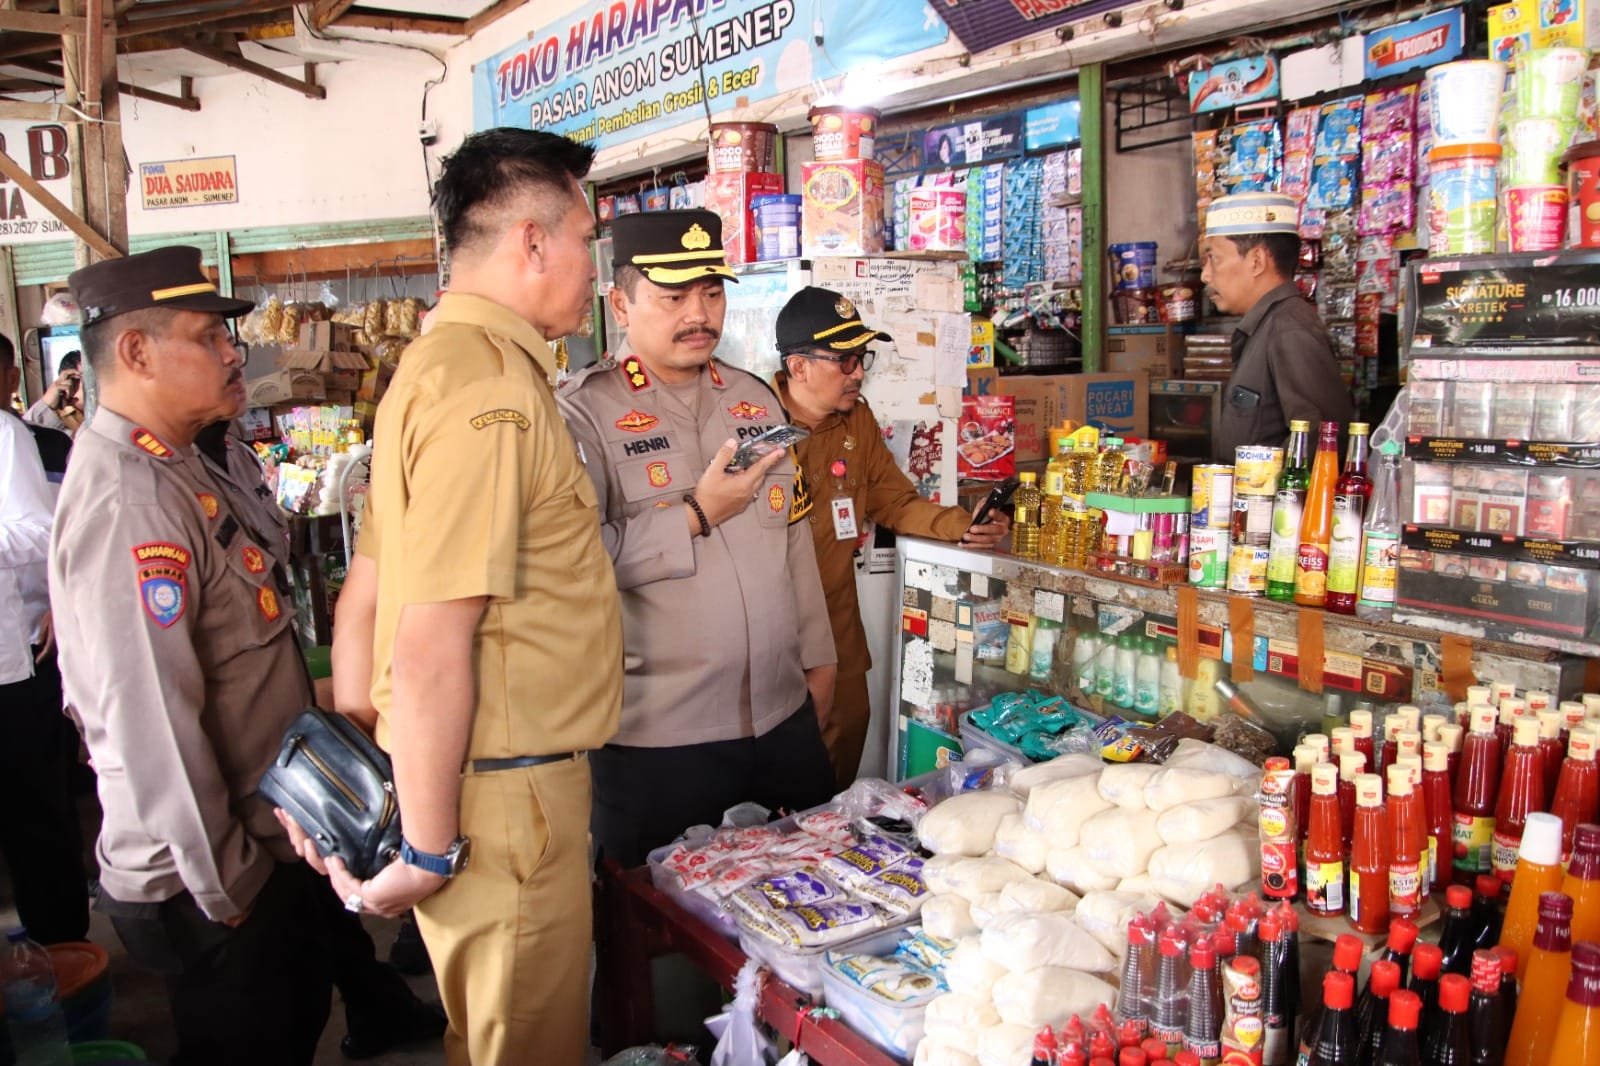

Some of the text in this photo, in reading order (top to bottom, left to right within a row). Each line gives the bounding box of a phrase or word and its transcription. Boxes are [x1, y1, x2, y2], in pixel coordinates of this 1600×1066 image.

[1395, 29, 1444, 60] PRODUCT
[496, 33, 561, 103] TOKO
[529, 0, 794, 128] PASAR ANOM SUMENEP
[597, 106, 661, 137] Pembelian
[663, 85, 704, 112] Grosir
[707, 78, 719, 98] &
[722, 65, 760, 94] Ecer
[813, 132, 842, 144] CHOCO
[145, 170, 234, 196] DUA SAUDARA
[170, 196, 188, 205] ANOM
[203, 193, 234, 202] SUMENEP
[1446, 284, 1526, 299] SIGNATURE
[1459, 302, 1508, 313] KRETEK
[1088, 390, 1133, 401] POCARI
[977, 407, 1011, 416] ROMANCE
[1087, 402, 1128, 414] SWEAT
[623, 435, 670, 456] HENRI
[1475, 444, 1495, 454] 16.000
[1425, 531, 1460, 541] SIGNATURE
[1471, 538, 1491, 549] 16.000
[1524, 541, 1564, 552] SIGNATURE
[1576, 548, 1600, 560] 16.000
[143, 569, 183, 580] BINMAS
